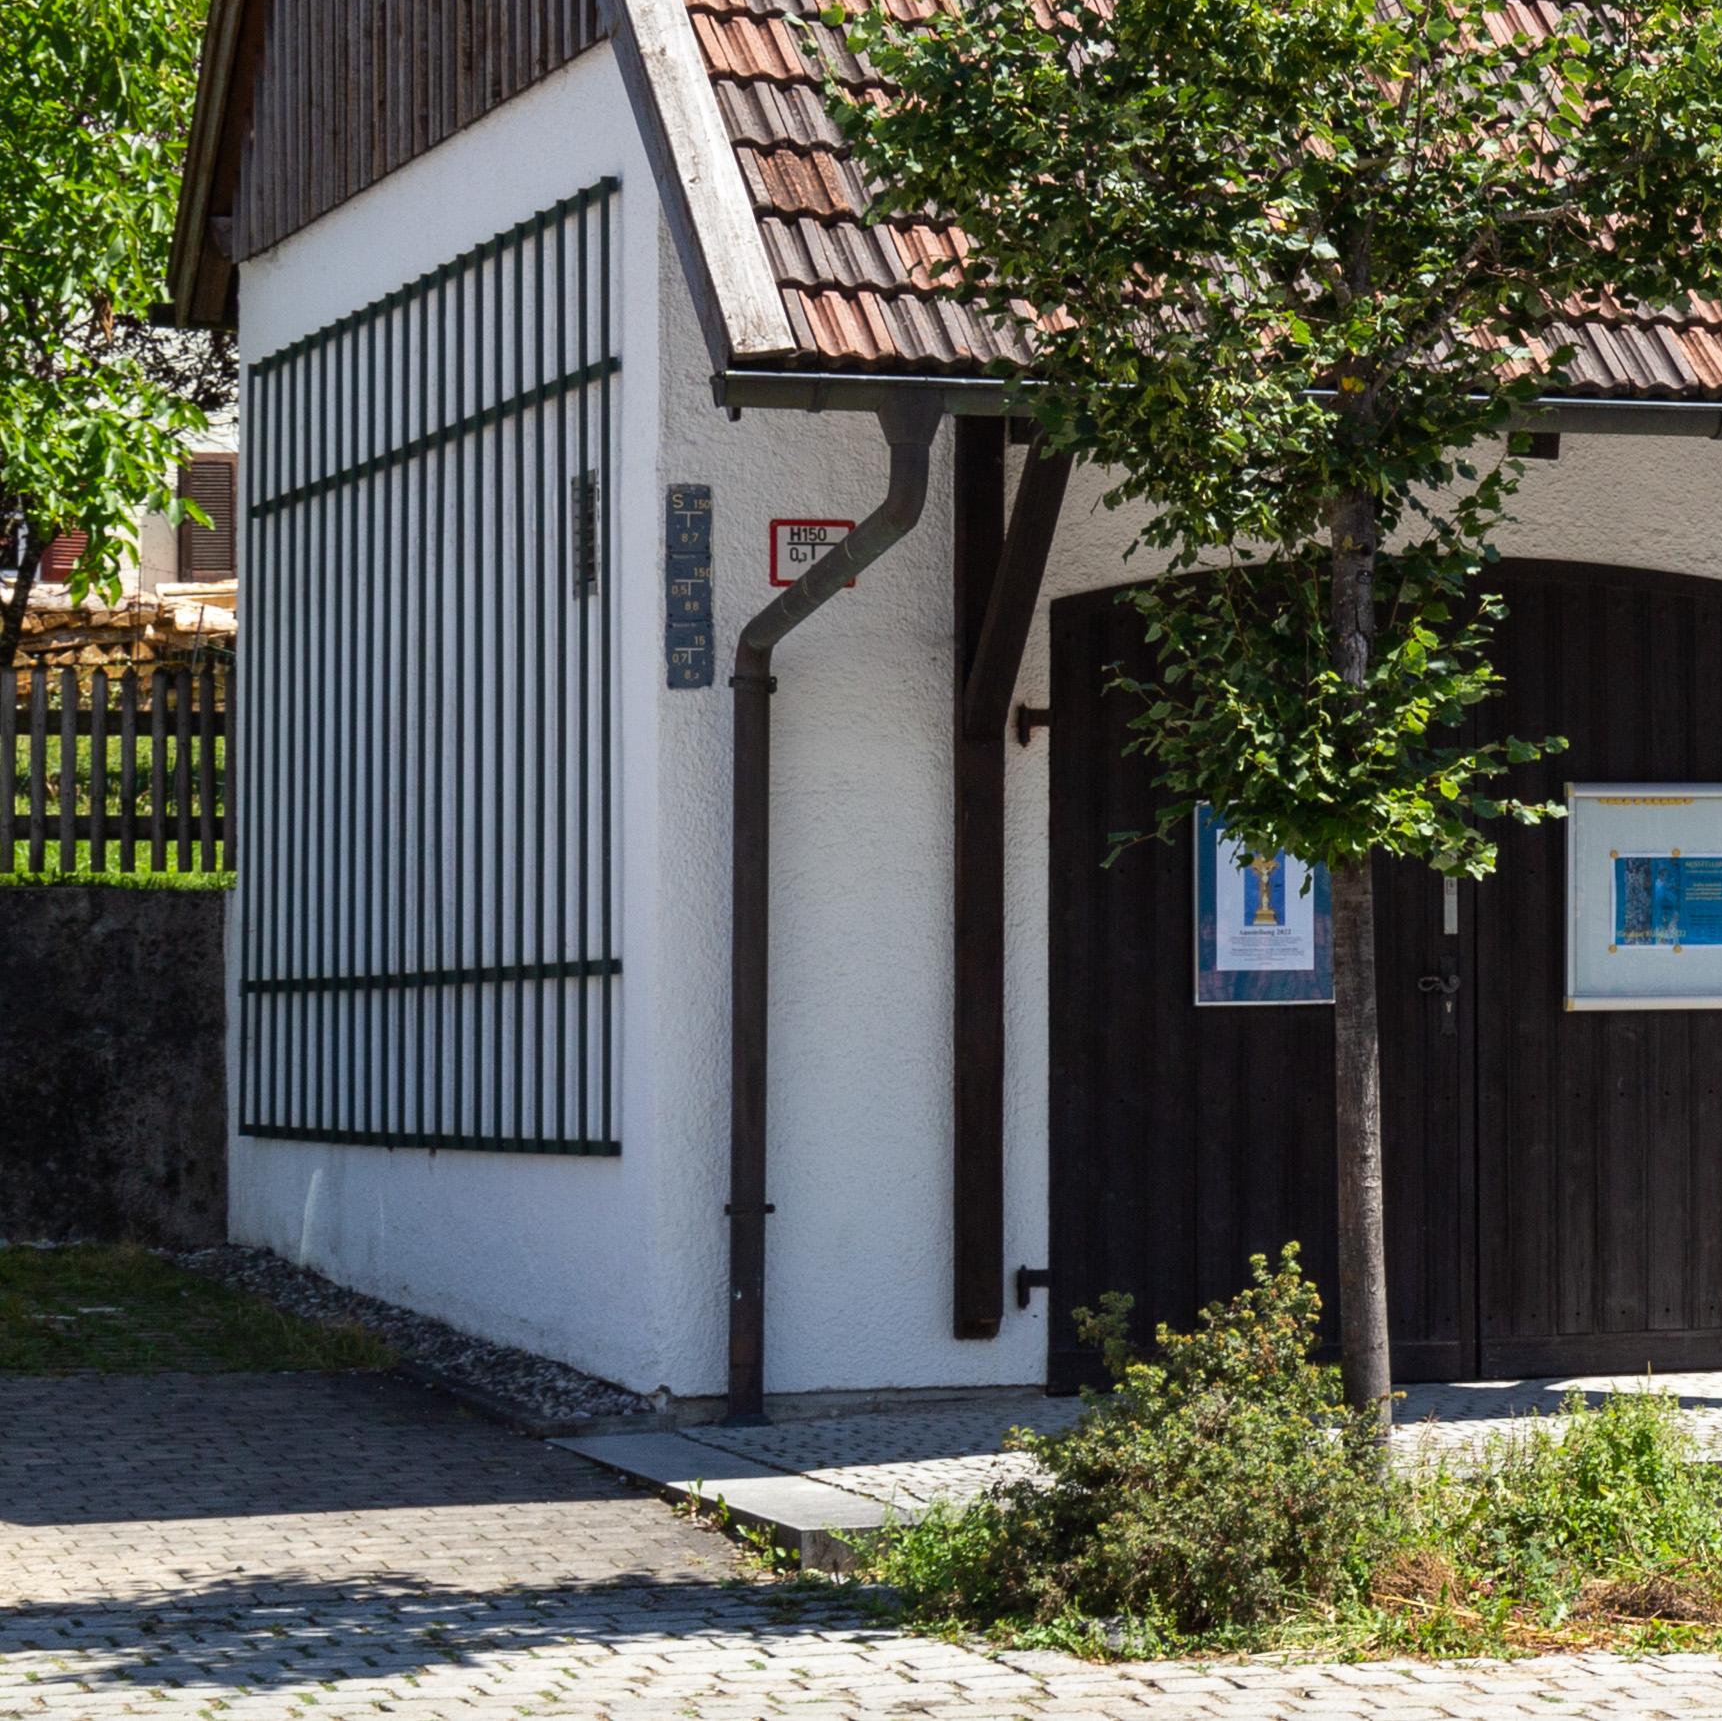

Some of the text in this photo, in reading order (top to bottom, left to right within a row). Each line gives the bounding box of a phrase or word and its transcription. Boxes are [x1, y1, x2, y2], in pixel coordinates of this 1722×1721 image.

[672, 493, 684, 509] S
[693, 499, 713, 510] 150
[789, 527, 828, 542] H150
